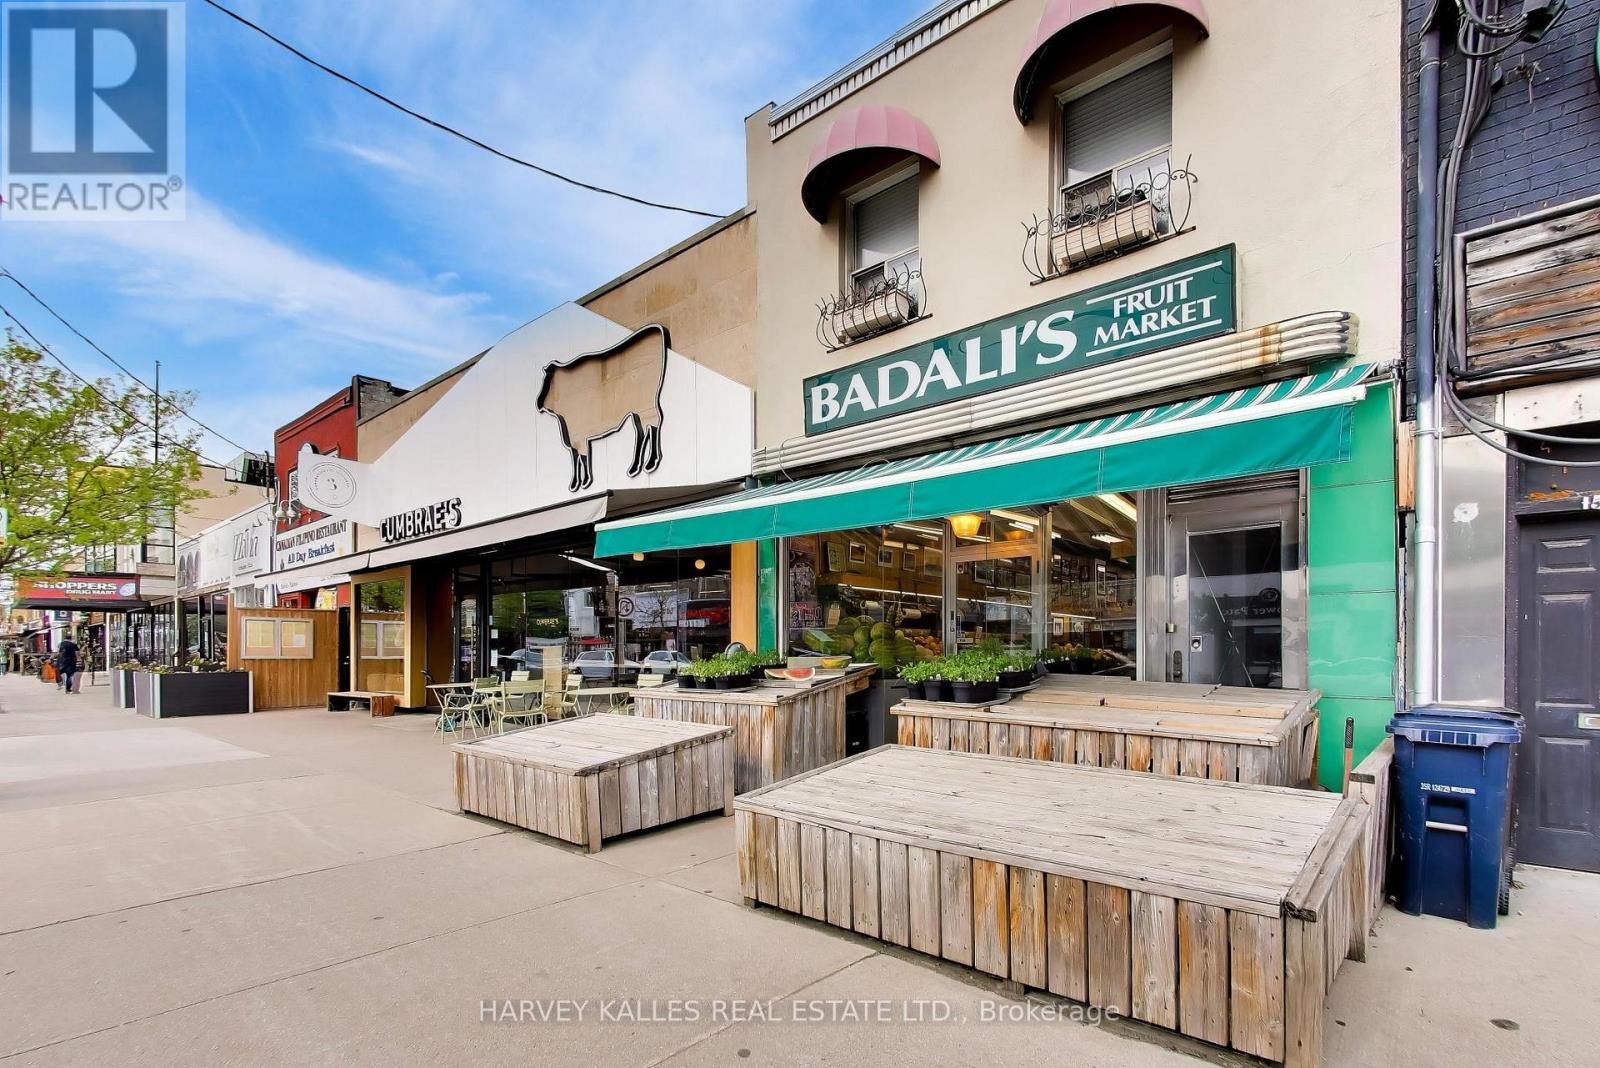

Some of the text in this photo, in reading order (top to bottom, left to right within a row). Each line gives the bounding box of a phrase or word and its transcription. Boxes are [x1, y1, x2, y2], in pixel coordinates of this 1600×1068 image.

[1112, 276, 1194, 319] FRUIT
[1093, 296, 1217, 347] MARKET
[811, 309, 1079, 425] BADALI'S
[316, 519, 347, 540] RESTAURANT
[380, 497, 462, 542] CUMBRAE'S
[296, 551, 306, 563] Day
[308, 542, 335, 559] Breakfast
